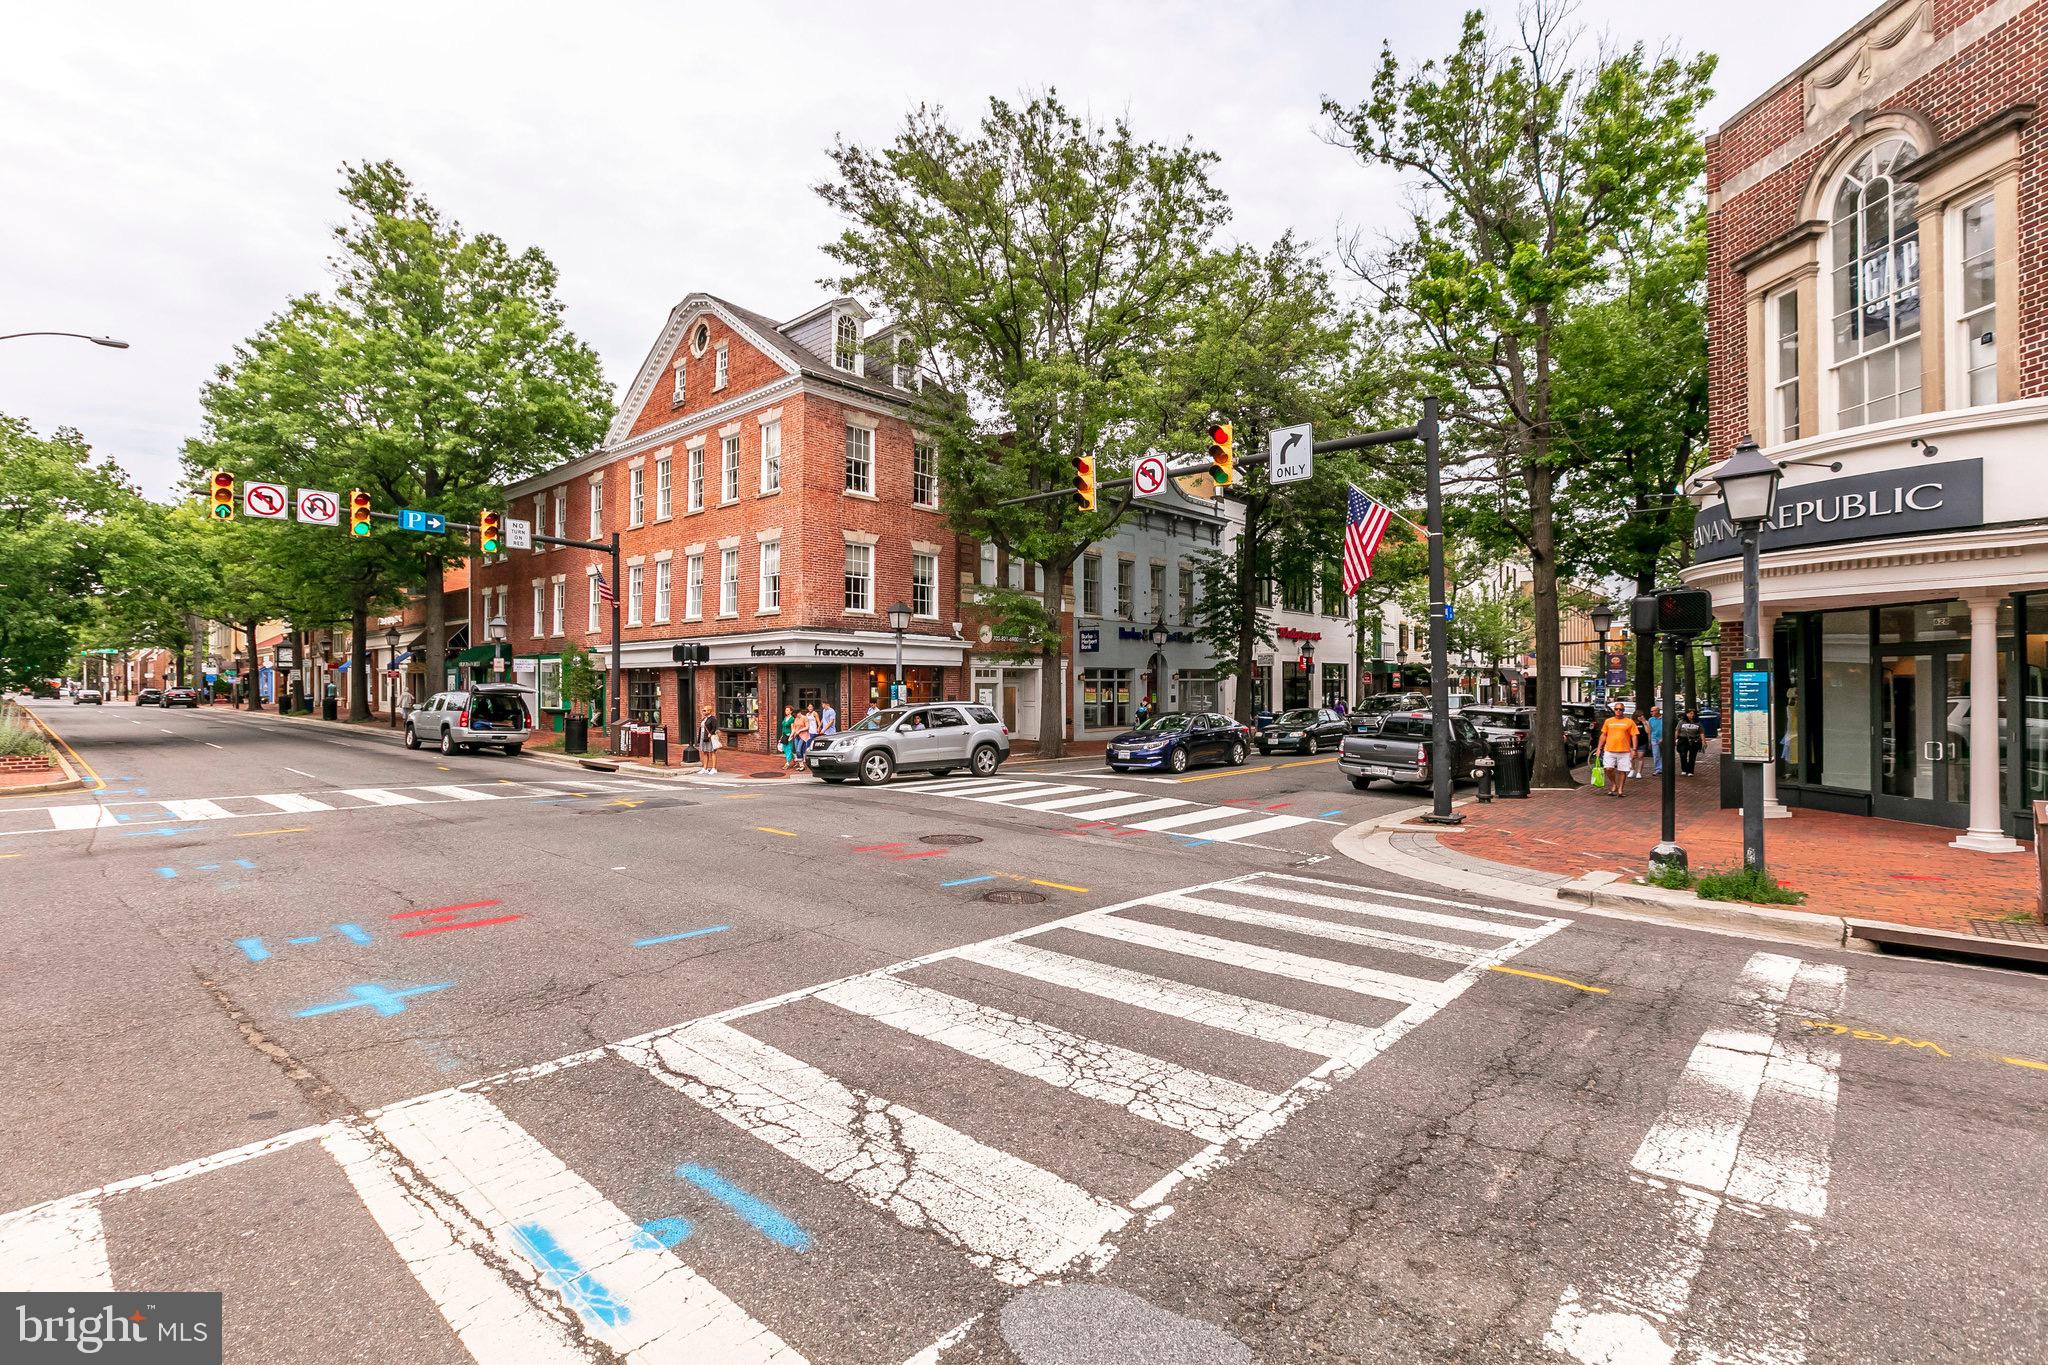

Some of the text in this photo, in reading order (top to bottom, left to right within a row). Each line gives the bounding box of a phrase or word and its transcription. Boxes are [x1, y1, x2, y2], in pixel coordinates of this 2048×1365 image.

[1277, 464, 1305, 478] ONLY
[408, 512, 422, 528] P
[751, 646, 785, 657] francesca's
[814, 644, 864, 657] francesca's
